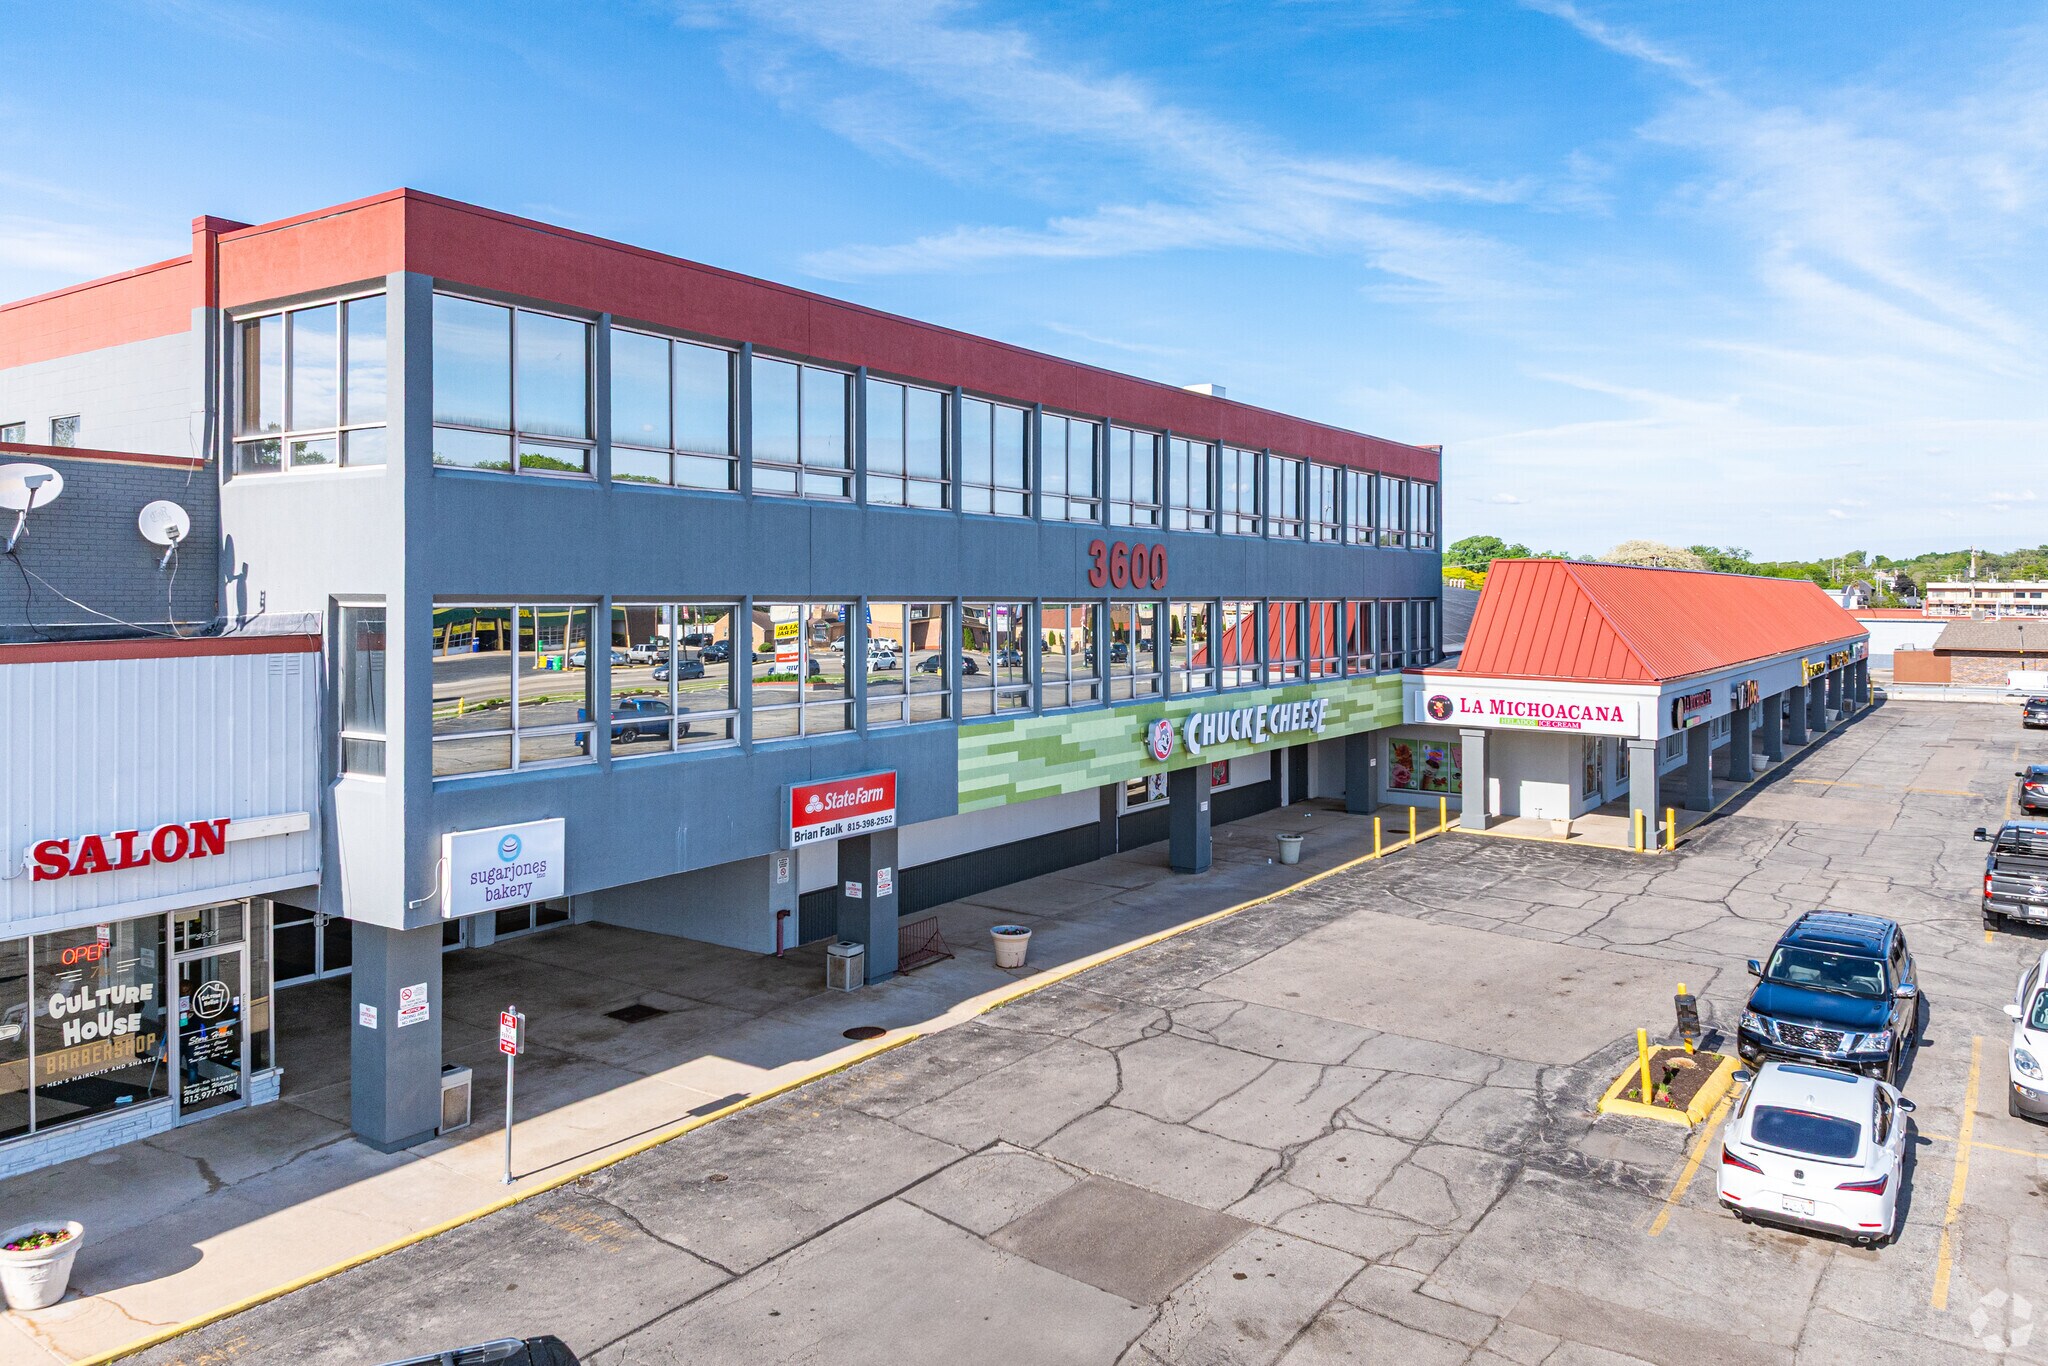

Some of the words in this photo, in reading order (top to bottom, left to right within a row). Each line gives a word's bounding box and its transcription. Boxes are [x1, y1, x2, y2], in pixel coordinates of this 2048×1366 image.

[1088, 538, 1168, 591] 3600
[1460, 697, 1484, 714] LA
[1489, 699, 1624, 722] MICHOACANA
[1501, 717, 1536, 726] HELADOS
[1538, 720, 1551, 728] ICE
[1552, 721, 1579, 729] CREAM
[1185, 707, 1253, 755] CHUCK
[1268, 698, 1328, 735] CHEESE
[794, 830, 818, 843] Brian
[820, 823, 843, 838] Faulk
[847, 815, 893, 832] 815-398-2552
[30, 817, 231, 882] SALON
[470, 860, 547, 886] sugarjones
[485, 882, 533, 902] bakery
[48, 983, 154, 1019] CULTURE
[62, 1010, 141, 1047] HOUSE
[46, 1032, 156, 1075] BARBERSHOP
[47, 1078, 69, 1089] MEN'S
[72, 1068, 108, 1082] HAIRCUTS
[111, 1064, 126, 1072] AND
[128, 1056, 156, 1068] SHAVES
[183, 1082, 238, 1105] 815.977.3081
